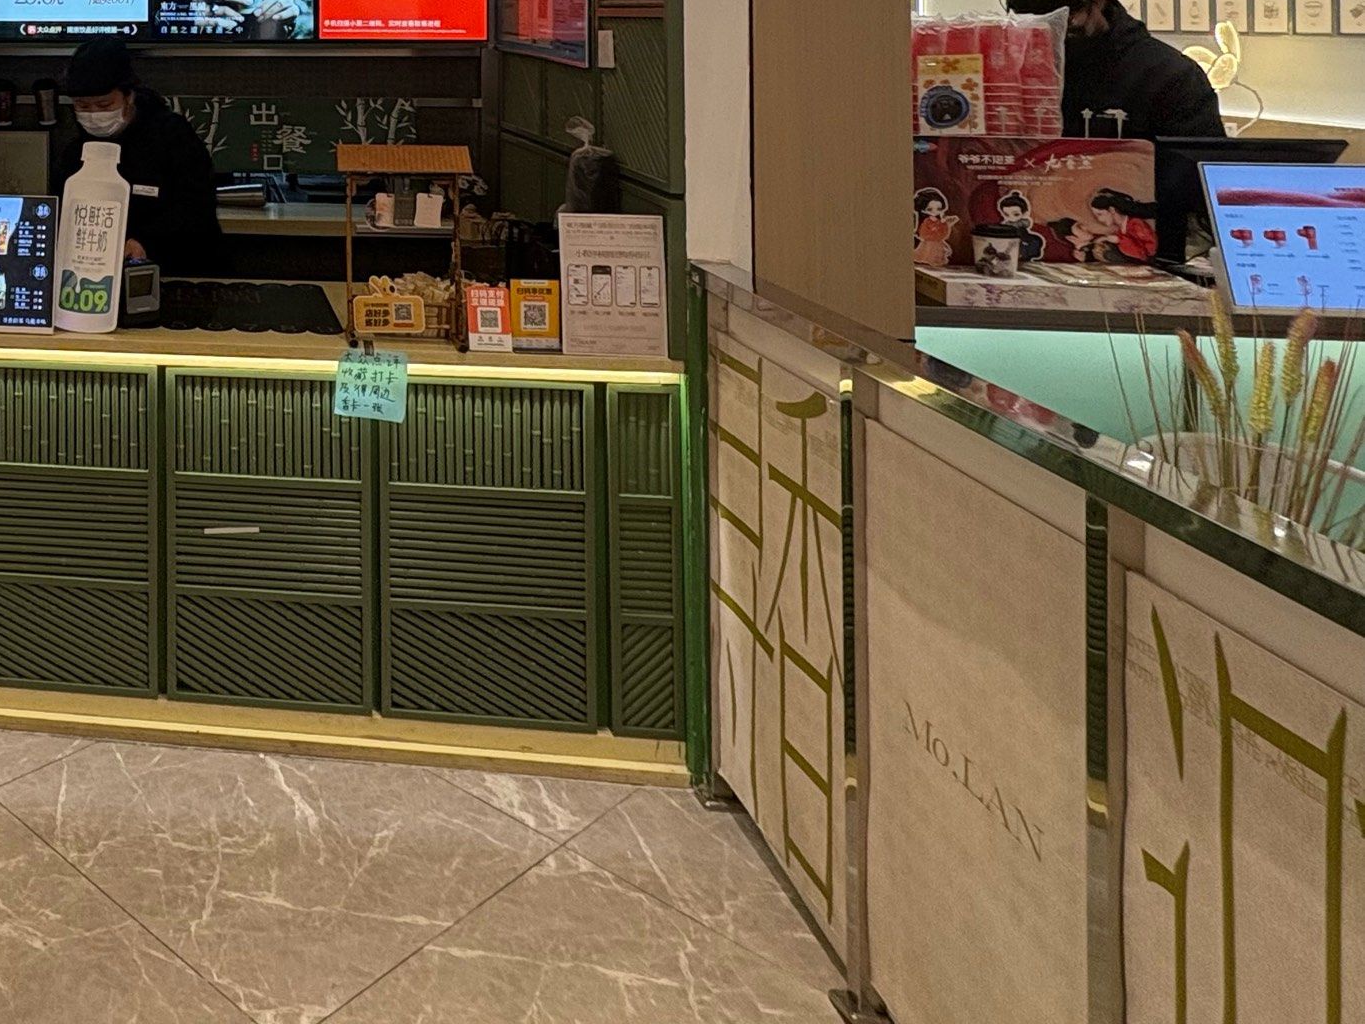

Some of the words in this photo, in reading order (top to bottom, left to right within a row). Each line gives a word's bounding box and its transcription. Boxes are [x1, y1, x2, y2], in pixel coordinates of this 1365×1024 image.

[250, 102, 312, 171] 出餐口
[75, 204, 115, 228] 悦鲜活
[75, 227, 108, 252] 鲜牛奶
